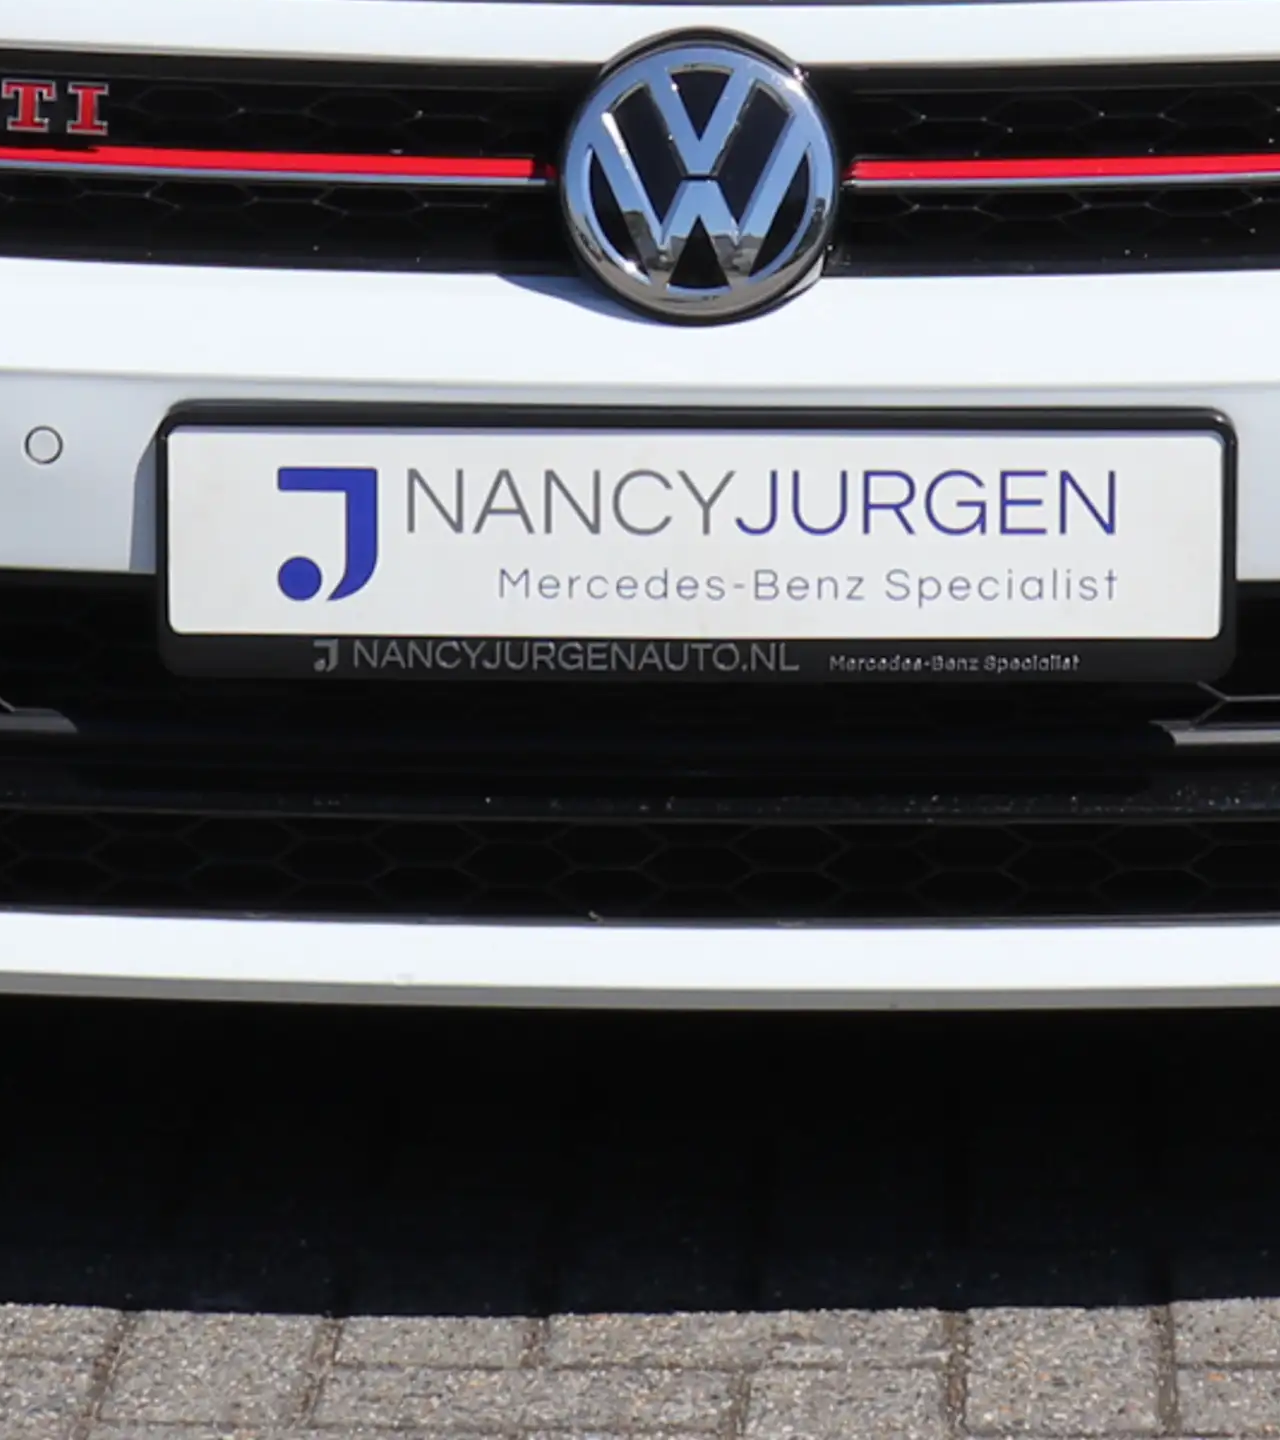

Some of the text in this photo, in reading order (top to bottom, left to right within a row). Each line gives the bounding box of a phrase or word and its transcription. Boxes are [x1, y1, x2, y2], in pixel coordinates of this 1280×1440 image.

[405, 466, 1118, 539] NANCYJURGEN
[498, 566, 1119, 610] Mercedes-Benz Specialist
[352, 638, 800, 673] NANCYJURGENAUTO.NL
[829, 653, 979, 673] Mercedes-Benz
[983, 653, 1081, 674] Specialist
